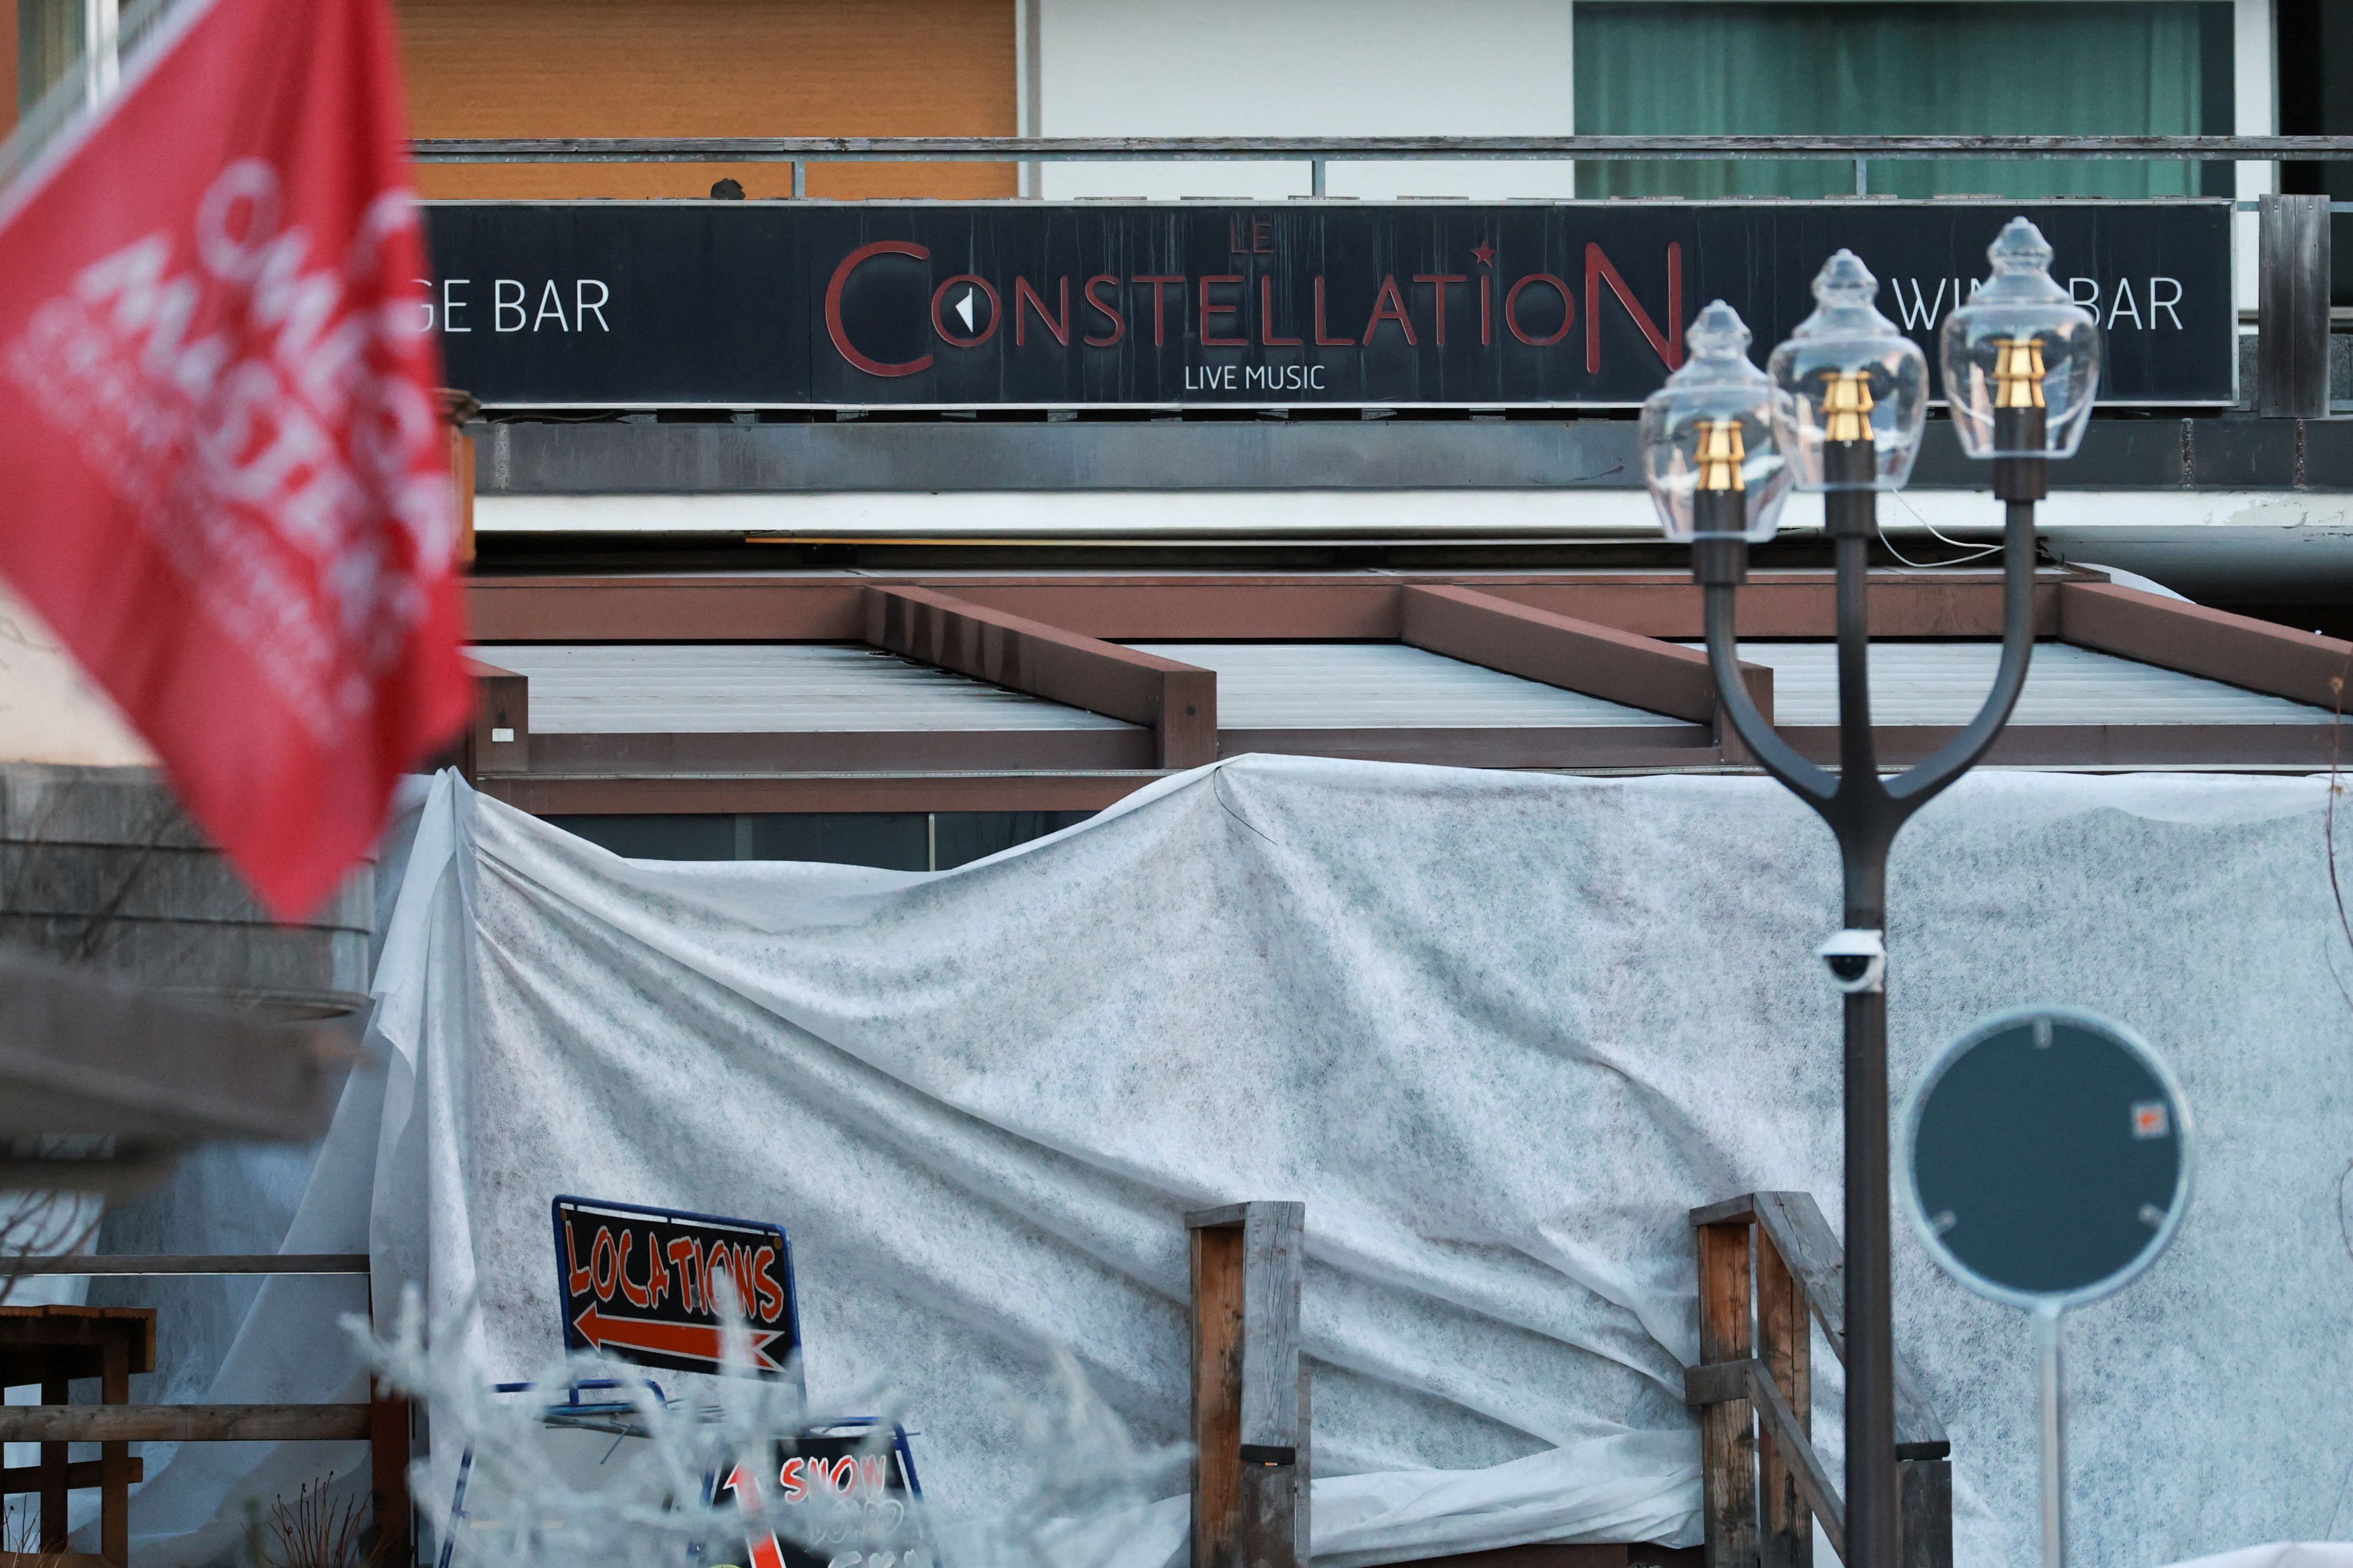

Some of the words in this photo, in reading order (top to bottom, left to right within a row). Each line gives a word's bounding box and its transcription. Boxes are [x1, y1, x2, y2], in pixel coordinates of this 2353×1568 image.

[1231, 221, 1275, 253] LE
[495, 279, 610, 332] BAR
[2069, 277, 2184, 330] BAR
[1185, 365, 1237, 389] LIVE
[1245, 365, 1325, 389] MUSIC
[565, 1220, 784, 1323] LOCATIONS
[780, 1454, 886, 1504] SNOW
